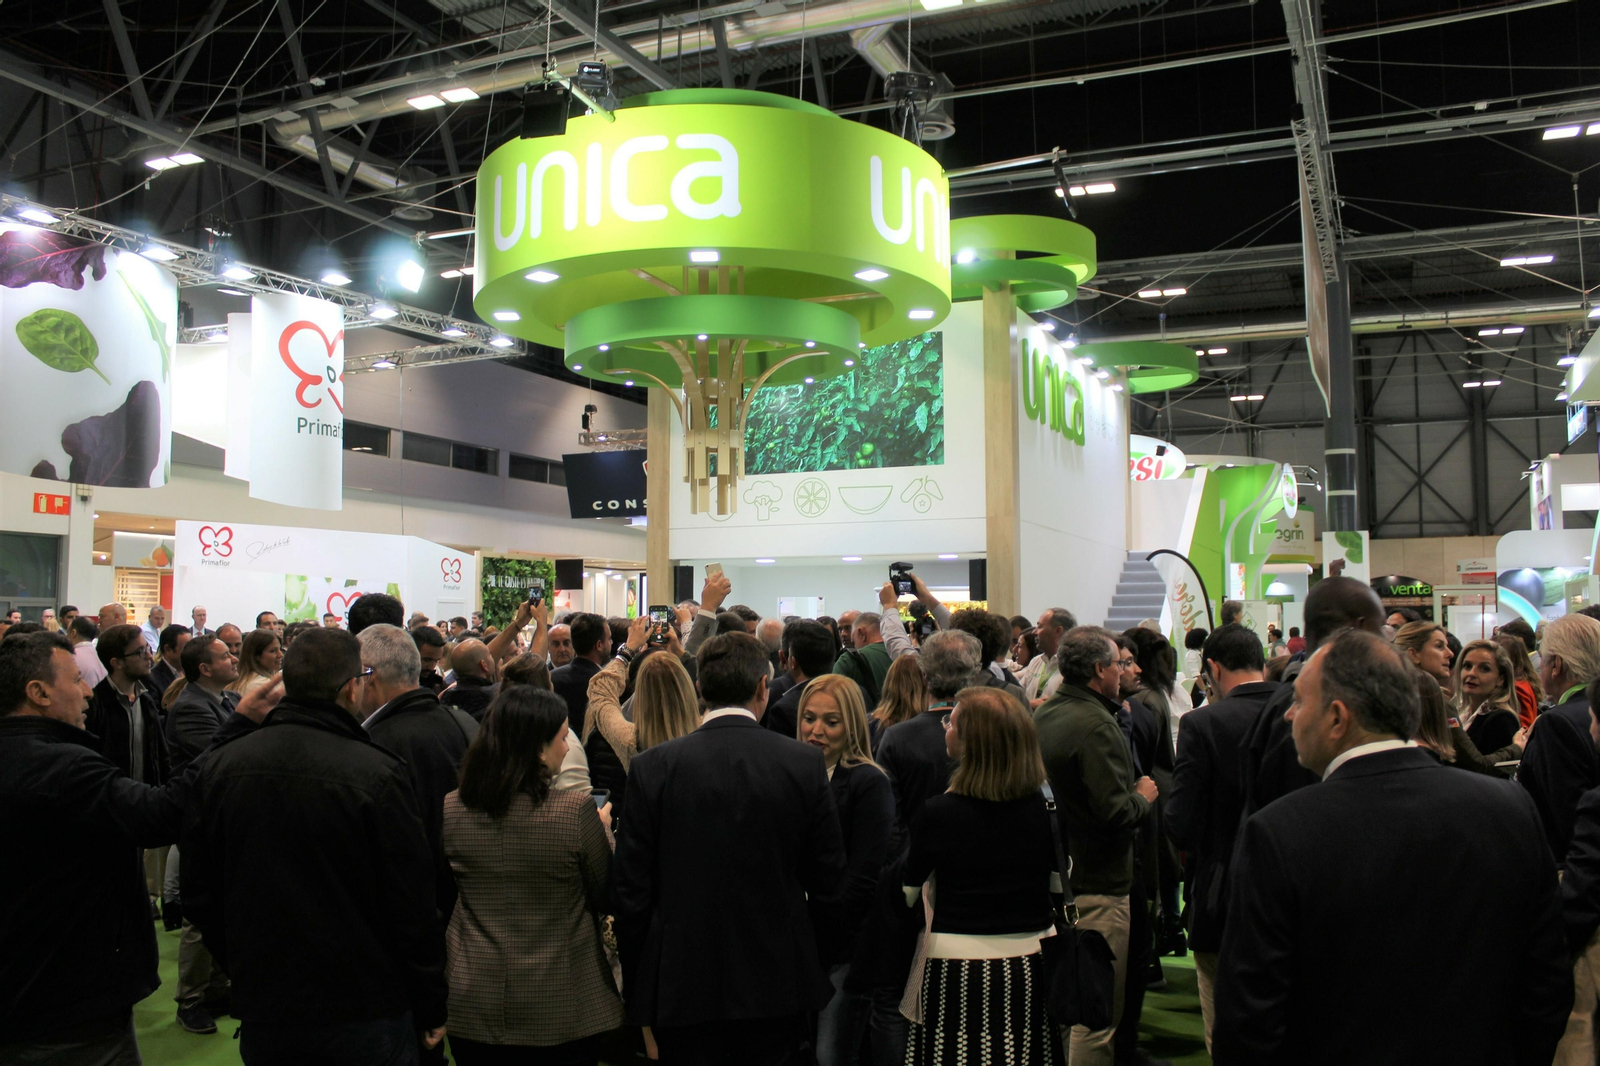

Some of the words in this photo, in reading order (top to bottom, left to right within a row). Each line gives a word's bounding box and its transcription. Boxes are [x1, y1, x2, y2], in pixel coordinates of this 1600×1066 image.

[494, 134, 742, 252] unica
[870, 155, 950, 268] uni
[1022, 338, 1085, 446] unica
